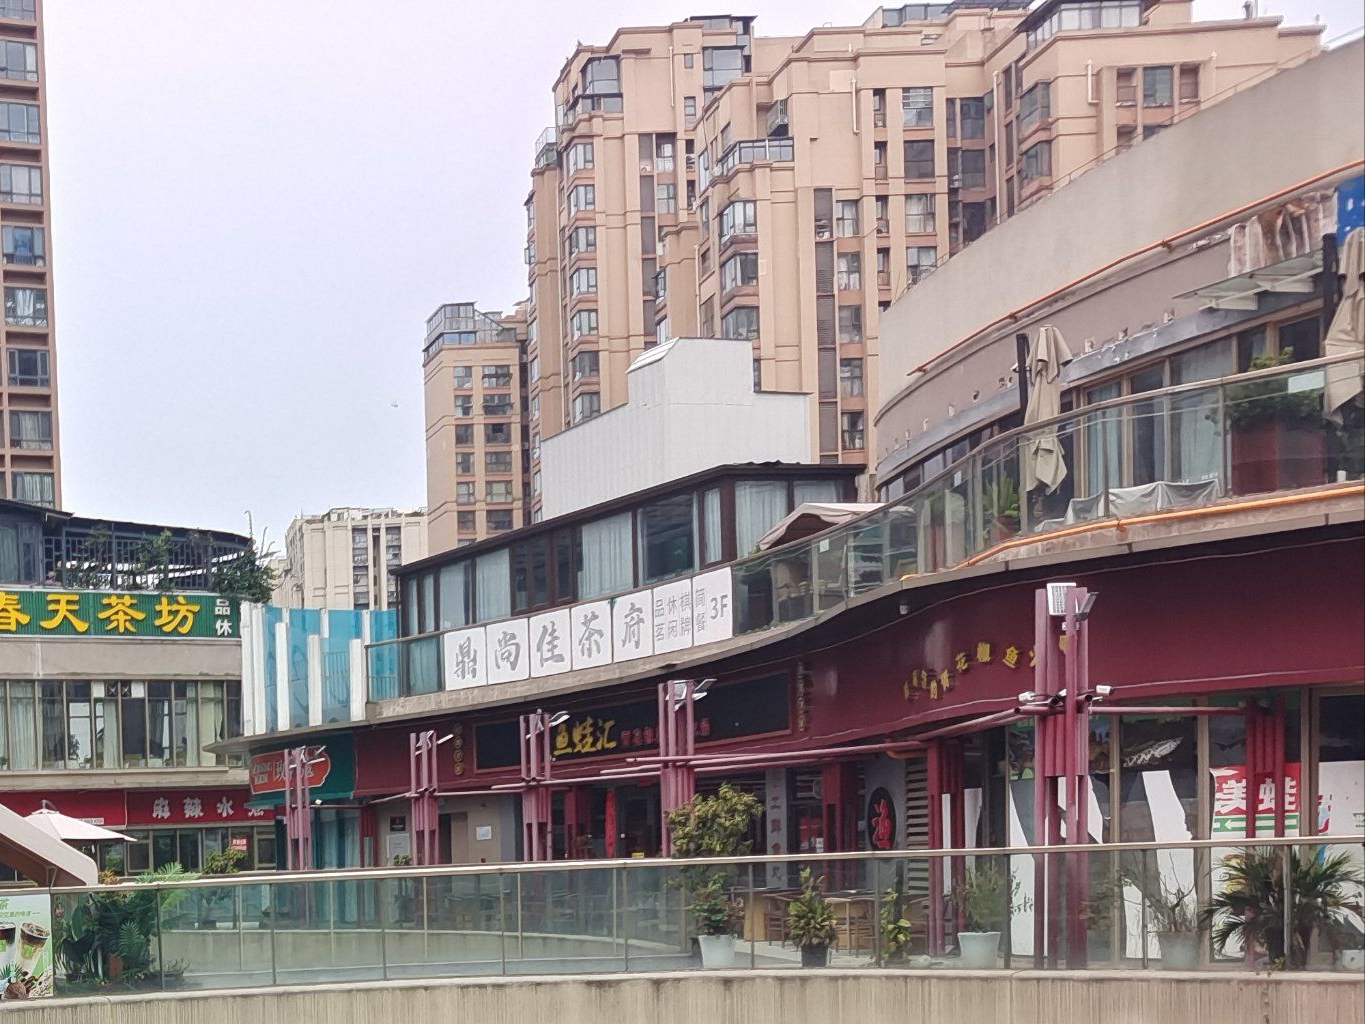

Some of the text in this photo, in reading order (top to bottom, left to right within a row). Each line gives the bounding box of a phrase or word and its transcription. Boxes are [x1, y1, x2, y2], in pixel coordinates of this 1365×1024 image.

[710, 594, 729, 620] 3F
[453, 601, 645, 680] 鼎尚佳茶府
[553, 718, 617, 755] 鱼蛙汇
